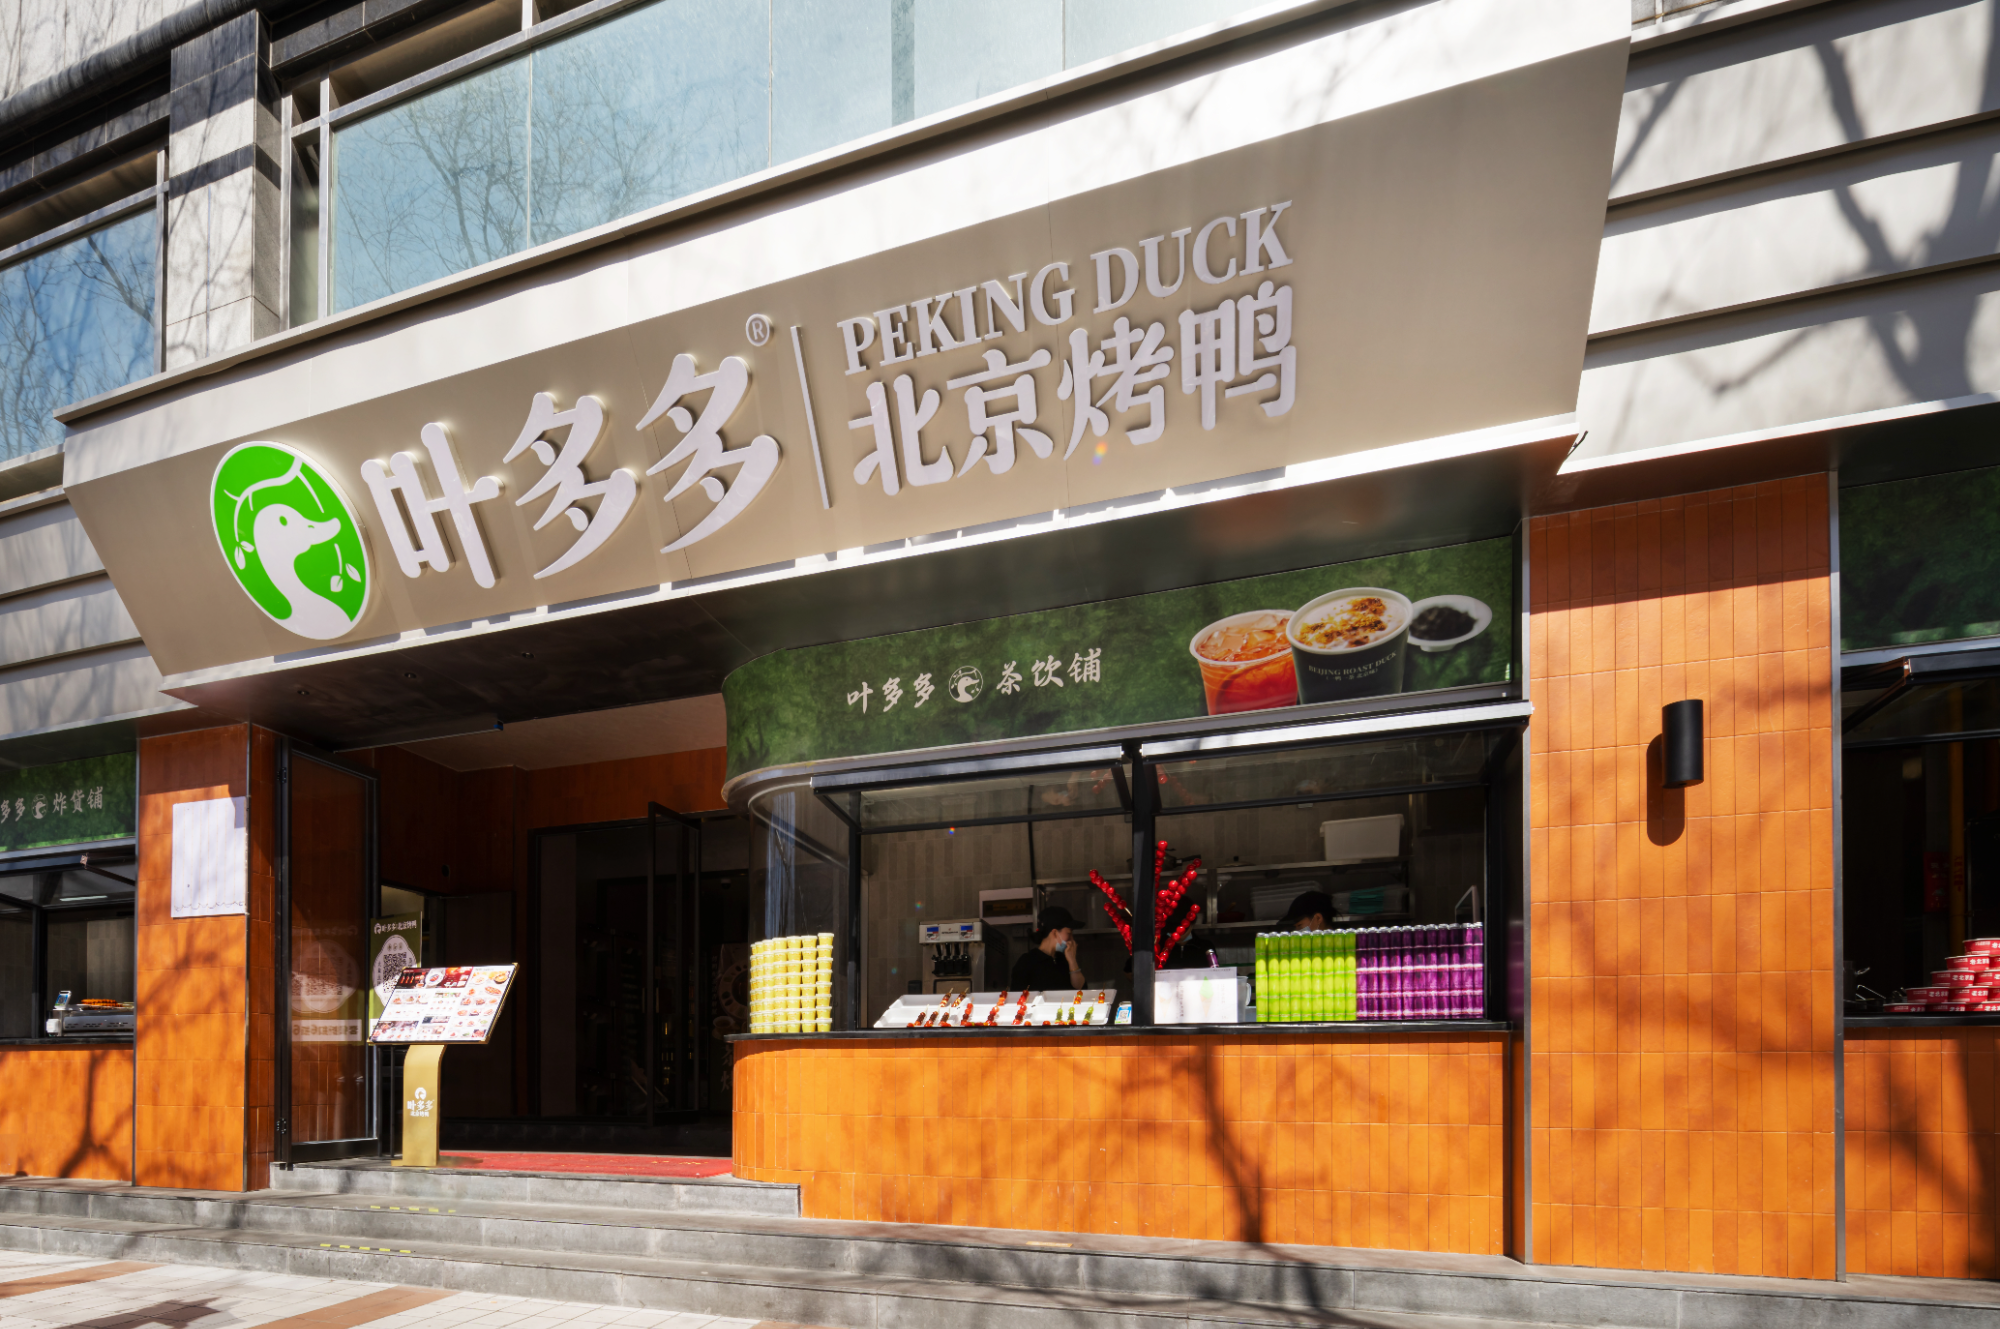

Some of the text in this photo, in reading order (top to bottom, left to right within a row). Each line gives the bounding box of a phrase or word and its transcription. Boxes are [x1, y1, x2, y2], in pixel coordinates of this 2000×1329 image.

[836, 199, 1294, 376] PEKING DUCK
[847, 280, 1297, 496] 北京烤鸭
[360, 353, 782, 590] 叶多多
[846, 648, 1102, 714] 叶多多 茶饮铺
[1308, 650, 1397, 676] BEIJING ROAST DUCK
[52, 786, 104, 815] 炸货铺
[406, 1100, 434, 1111] 叶多多
